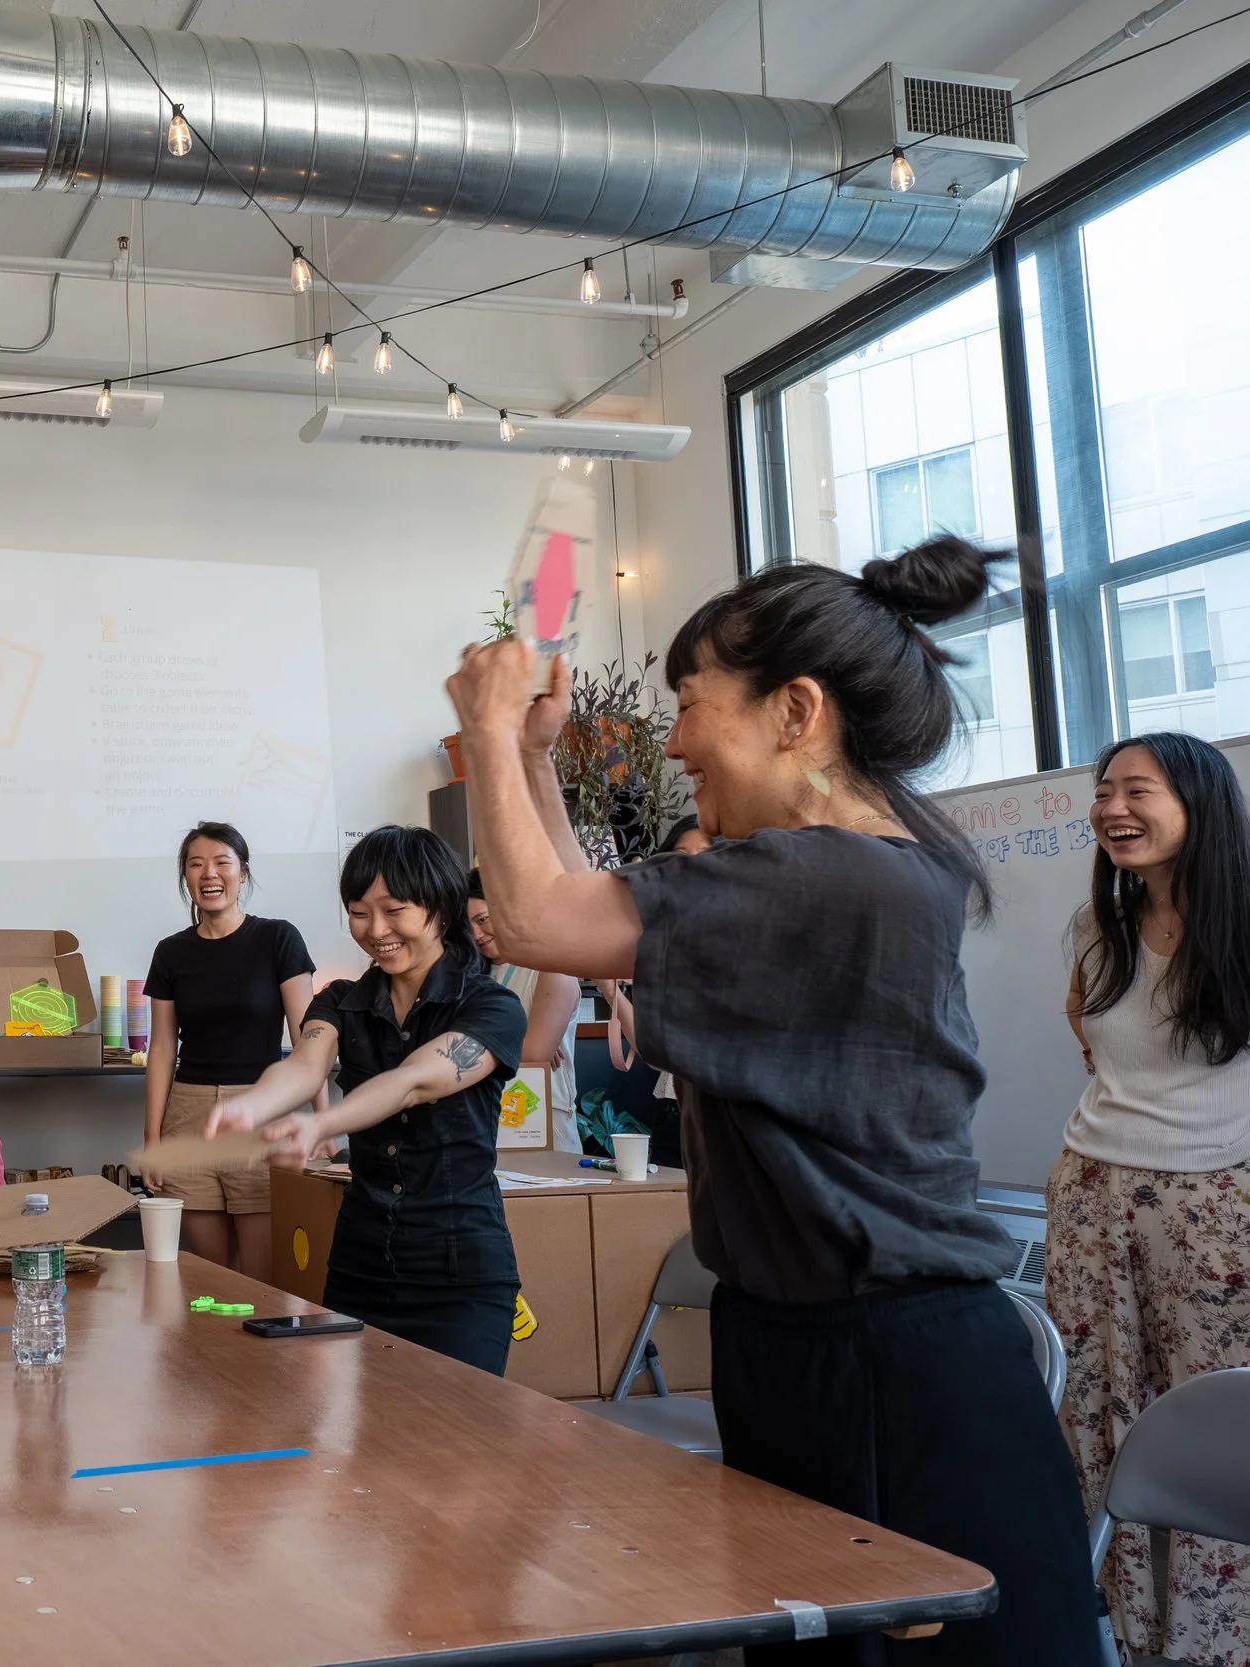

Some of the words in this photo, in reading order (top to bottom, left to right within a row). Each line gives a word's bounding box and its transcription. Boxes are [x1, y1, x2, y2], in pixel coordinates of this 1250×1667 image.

[1034, 786, 1072, 820] to
[986, 835, 1010, 863] OF
[1015, 826, 1060, 857] THE
